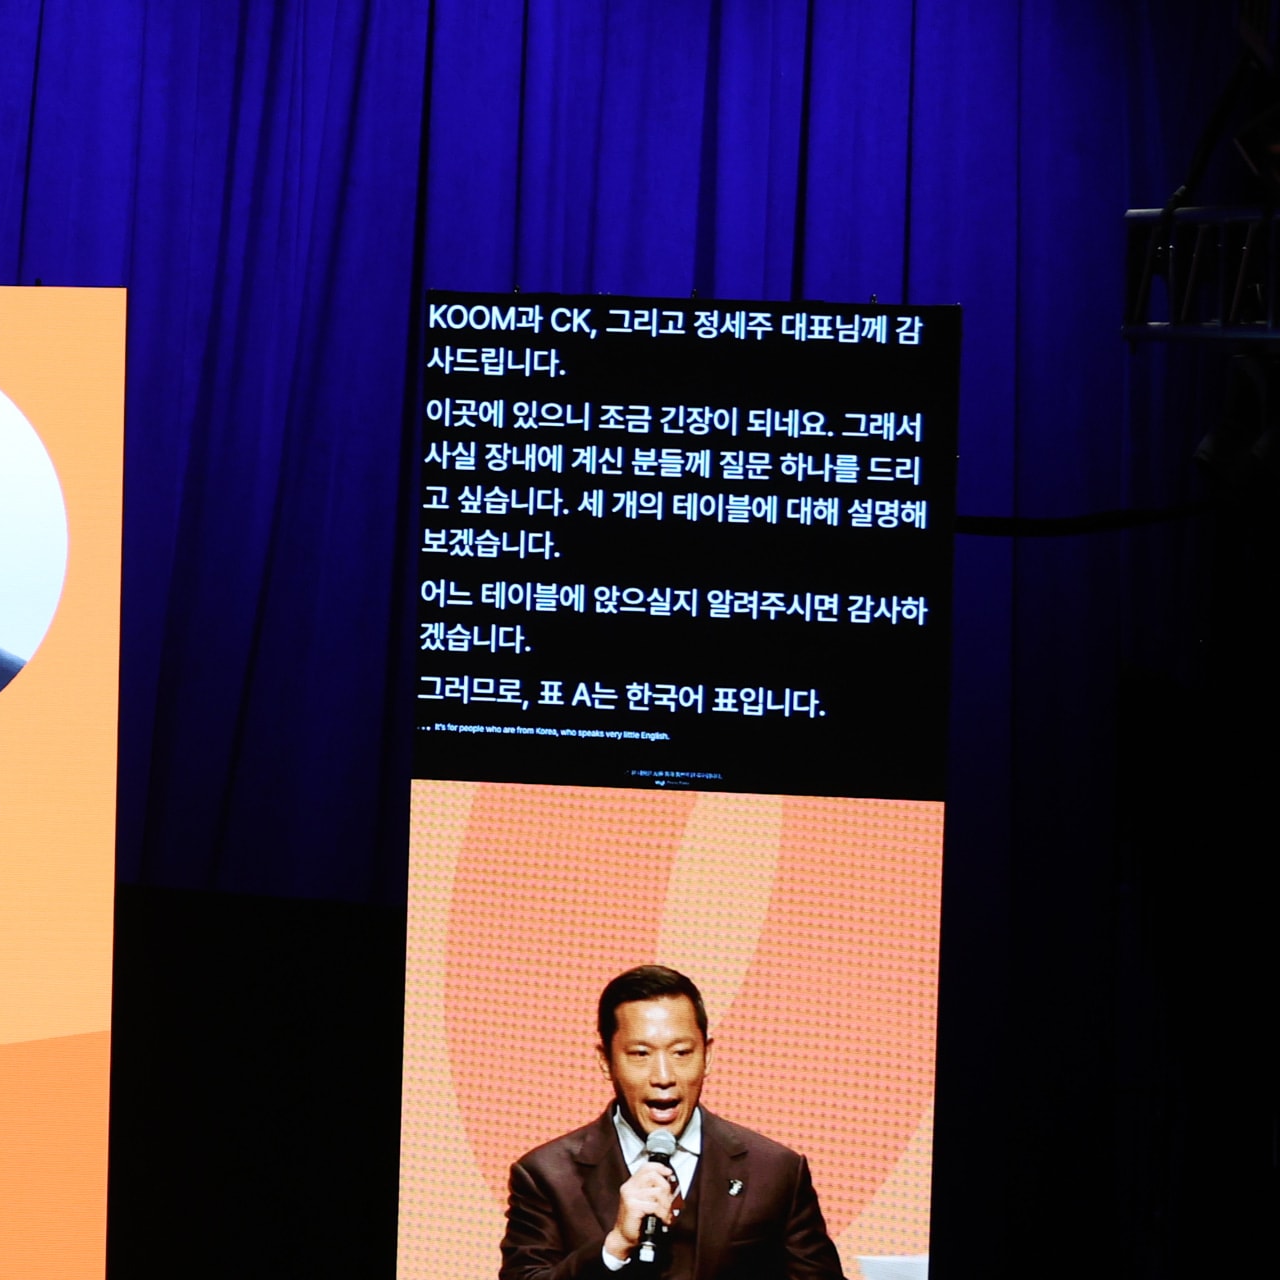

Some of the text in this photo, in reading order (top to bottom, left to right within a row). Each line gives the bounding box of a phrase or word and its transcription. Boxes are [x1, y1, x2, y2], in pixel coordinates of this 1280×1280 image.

[429, 303, 924, 345] KOOM과 CK, 그리고 정세주 대표님께 감
[426, 345, 566, 378] 사드립니다.
[426, 397, 922, 443] 이곳에 있으니 조금 긴장이 되네요. 그래서
[424, 440, 920, 486] 사실 장내에 계신 분들께 질문 하나를 드리
[422, 484, 927, 530] 고 싶습니다. 세 개의 테이블에 대해 설명해
[421, 527, 561, 560] 보겠습니다.
[421, 578, 929, 626] 어느 테이블에 앉으실지 알려주시면 감사하
[419, 621, 531, 654] 겠습니다.
[417, 675, 826, 719] 그러므로, 표 A는 한국어 표입니다.
